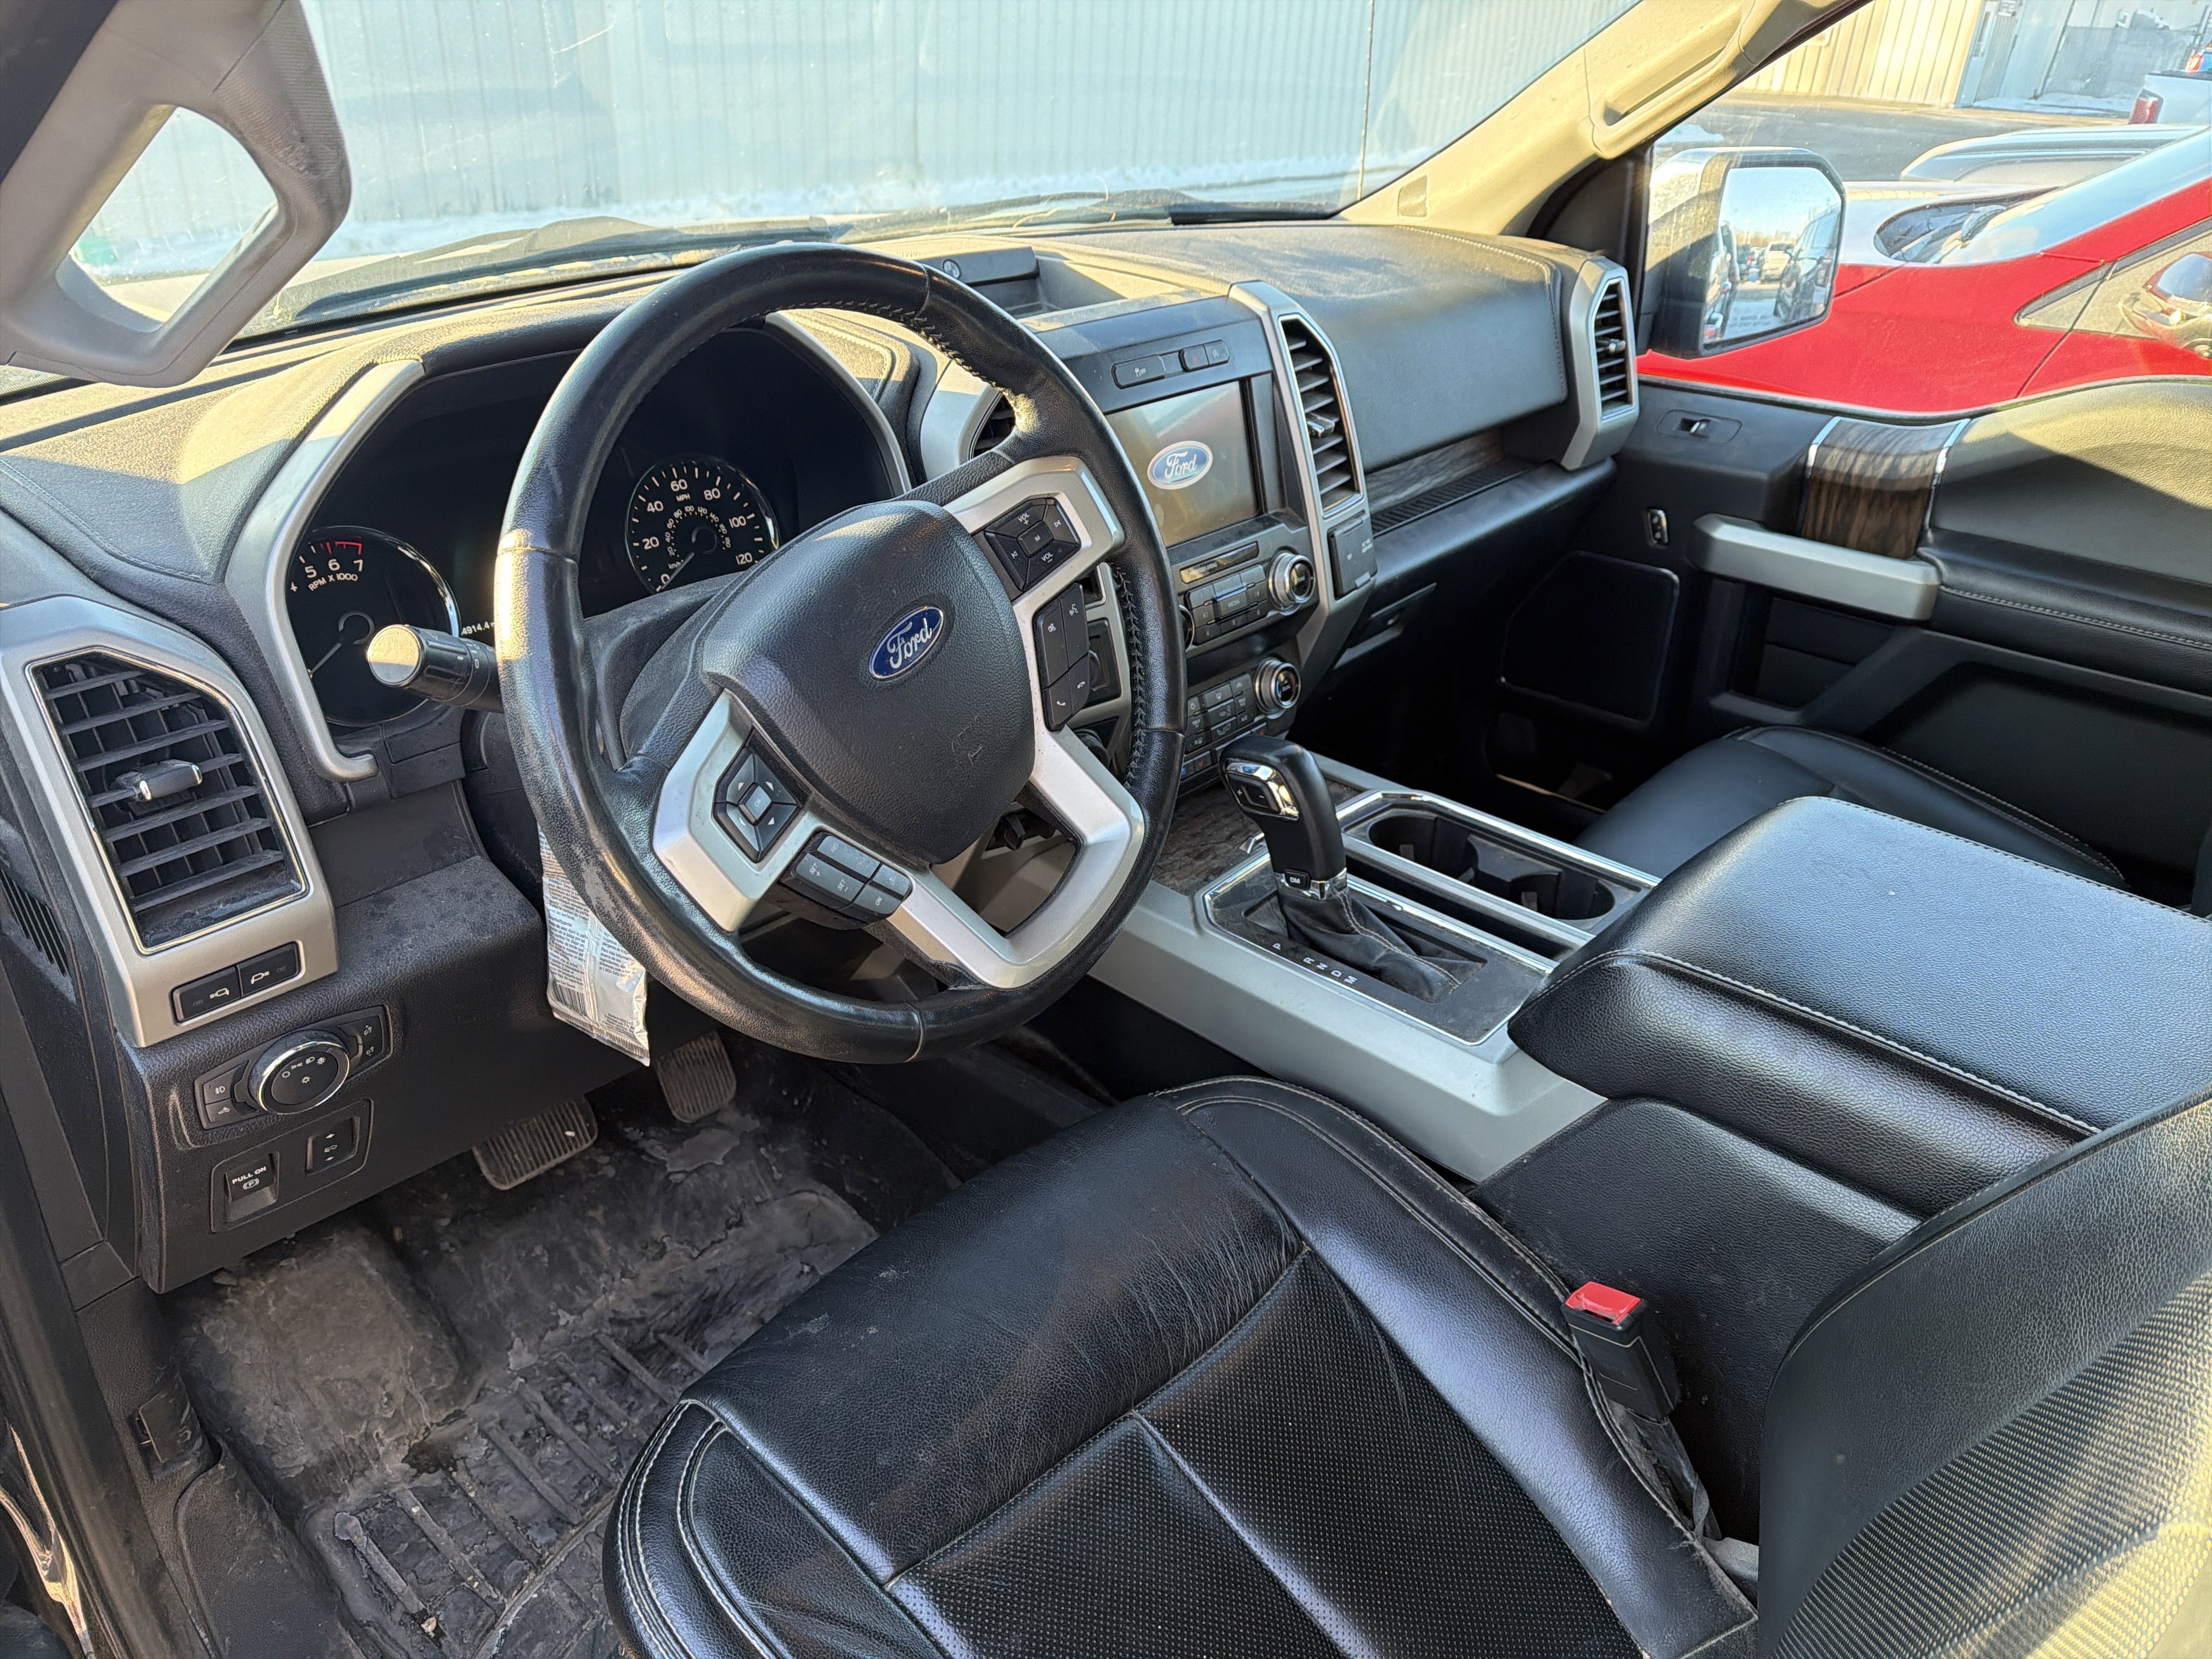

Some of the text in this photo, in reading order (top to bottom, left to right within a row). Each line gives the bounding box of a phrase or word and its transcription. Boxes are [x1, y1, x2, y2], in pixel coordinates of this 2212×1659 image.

[1164, 451, 1198, 479] Ford
[670, 479, 687, 492] 60
[676, 493, 691, 501] MPH
[703, 488, 720, 500] 80
[646, 501, 663, 513] 40
[697, 506, 708, 515] 120
[673, 509, 682, 518] 80
[1018, 512, 1030, 522] VOL
[667, 518, 674, 529] 60
[729, 516, 746, 528] 100
[642, 536, 659, 550] 20
[665, 532, 670, 543] 40
[667, 546, 675, 557] 20
[1041, 551, 1053, 561] VOL
[328, 558, 340, 571] 6
[736, 552, 753, 565] 120
[304, 565, 317, 578] 5
[353, 559, 363, 572] 7
[308, 577, 327, 591] RPM
[336, 572, 358, 582] 1000
[661, 573, 670, 584] 0
[290, 581, 298, 591] 4
[461, 621, 490, 636] 4914.4
[887, 617, 932, 669] Ford
[809, 863, 819, 875] SET
[837, 878, 847, 891] SET
[875, 896, 882, 906] ON
[1316, 962, 1328, 970] N
[1344, 975, 1358, 984] M
[232, 1166, 267, 1184] PULL ON
